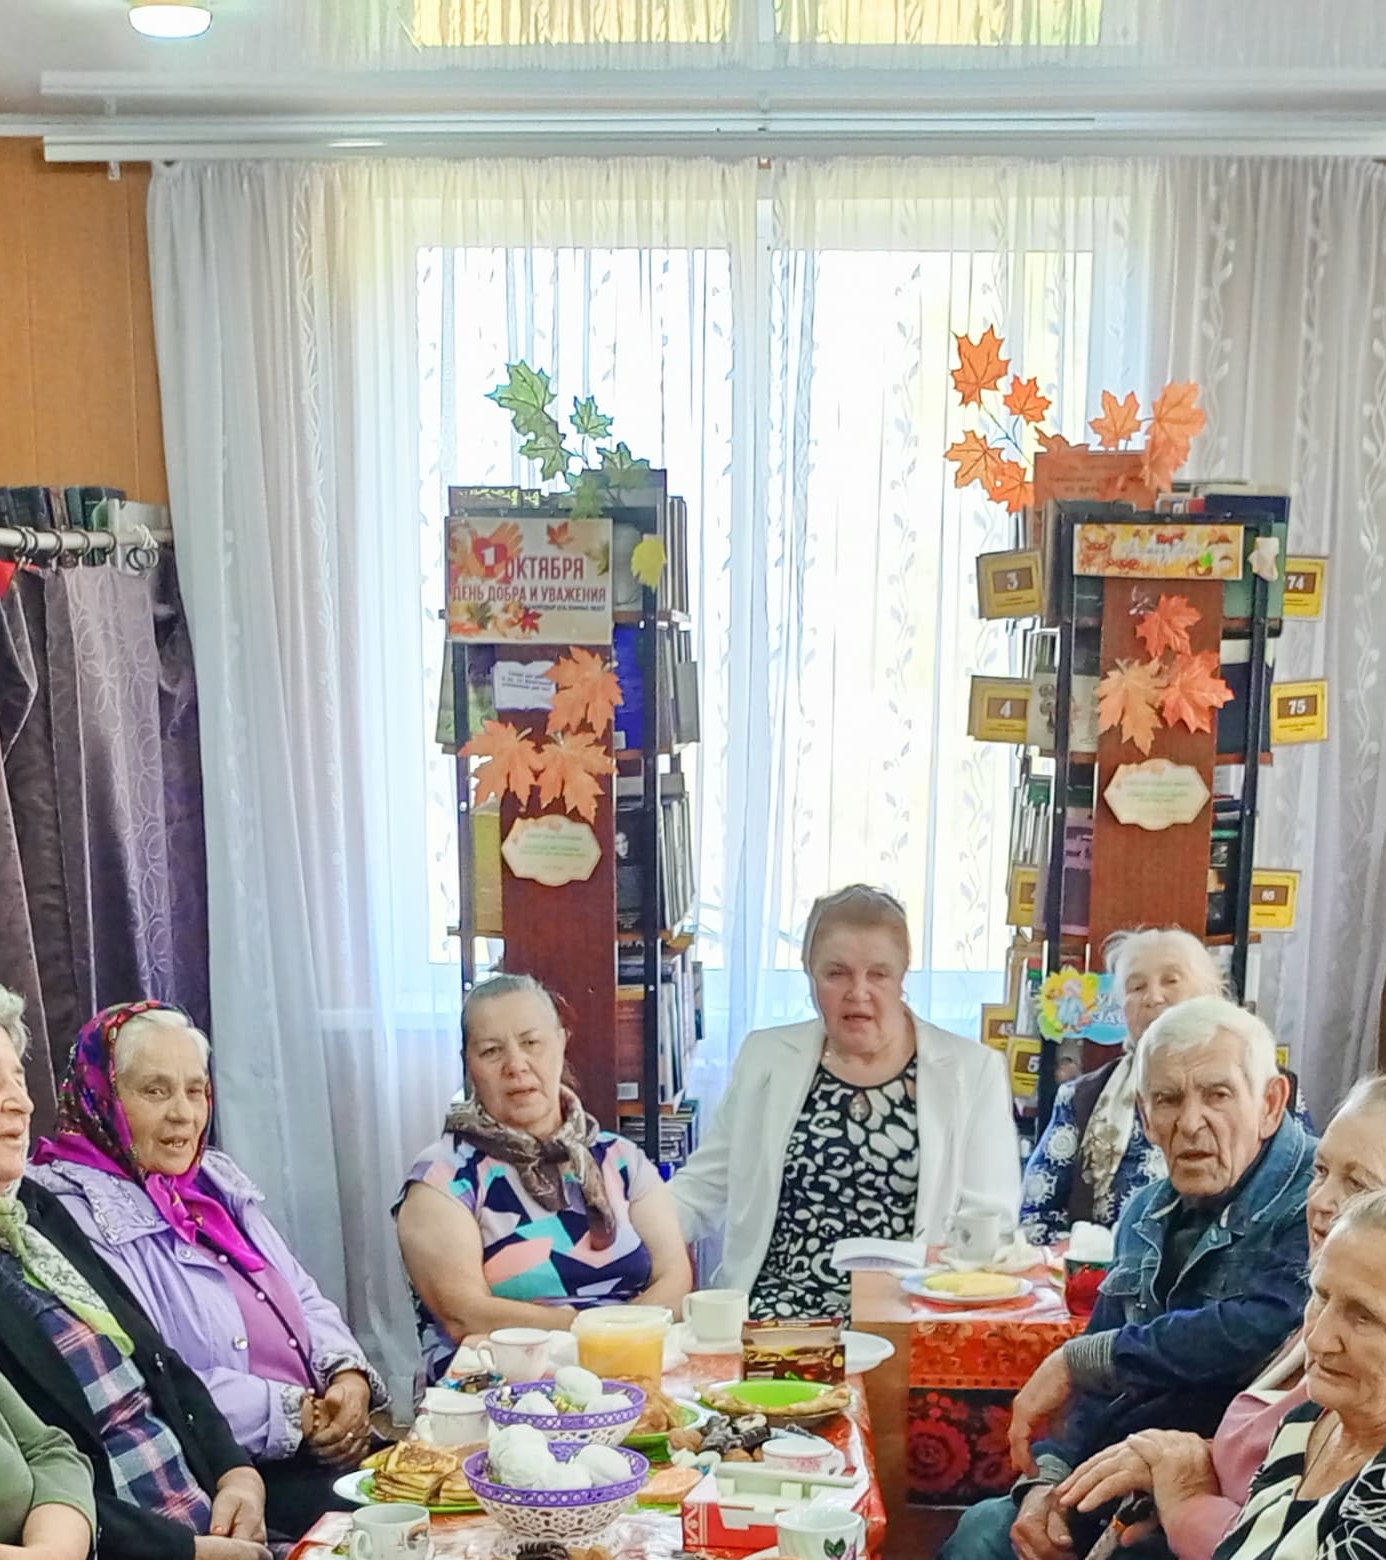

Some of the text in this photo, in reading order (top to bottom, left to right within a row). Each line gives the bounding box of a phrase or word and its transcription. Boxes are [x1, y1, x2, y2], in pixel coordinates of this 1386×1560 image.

[481, 546, 584, 581] 1 ОКТЯБРЯ
[1006, 571, 1019, 590] 3
[1287, 574, 1305, 591] 74
[453, 585, 606, 602] ДЕНЬ ДОБРА И УВАЖЕНИЯ
[999, 699, 1012, 719] 4
[1288, 699, 1307, 715] 75
